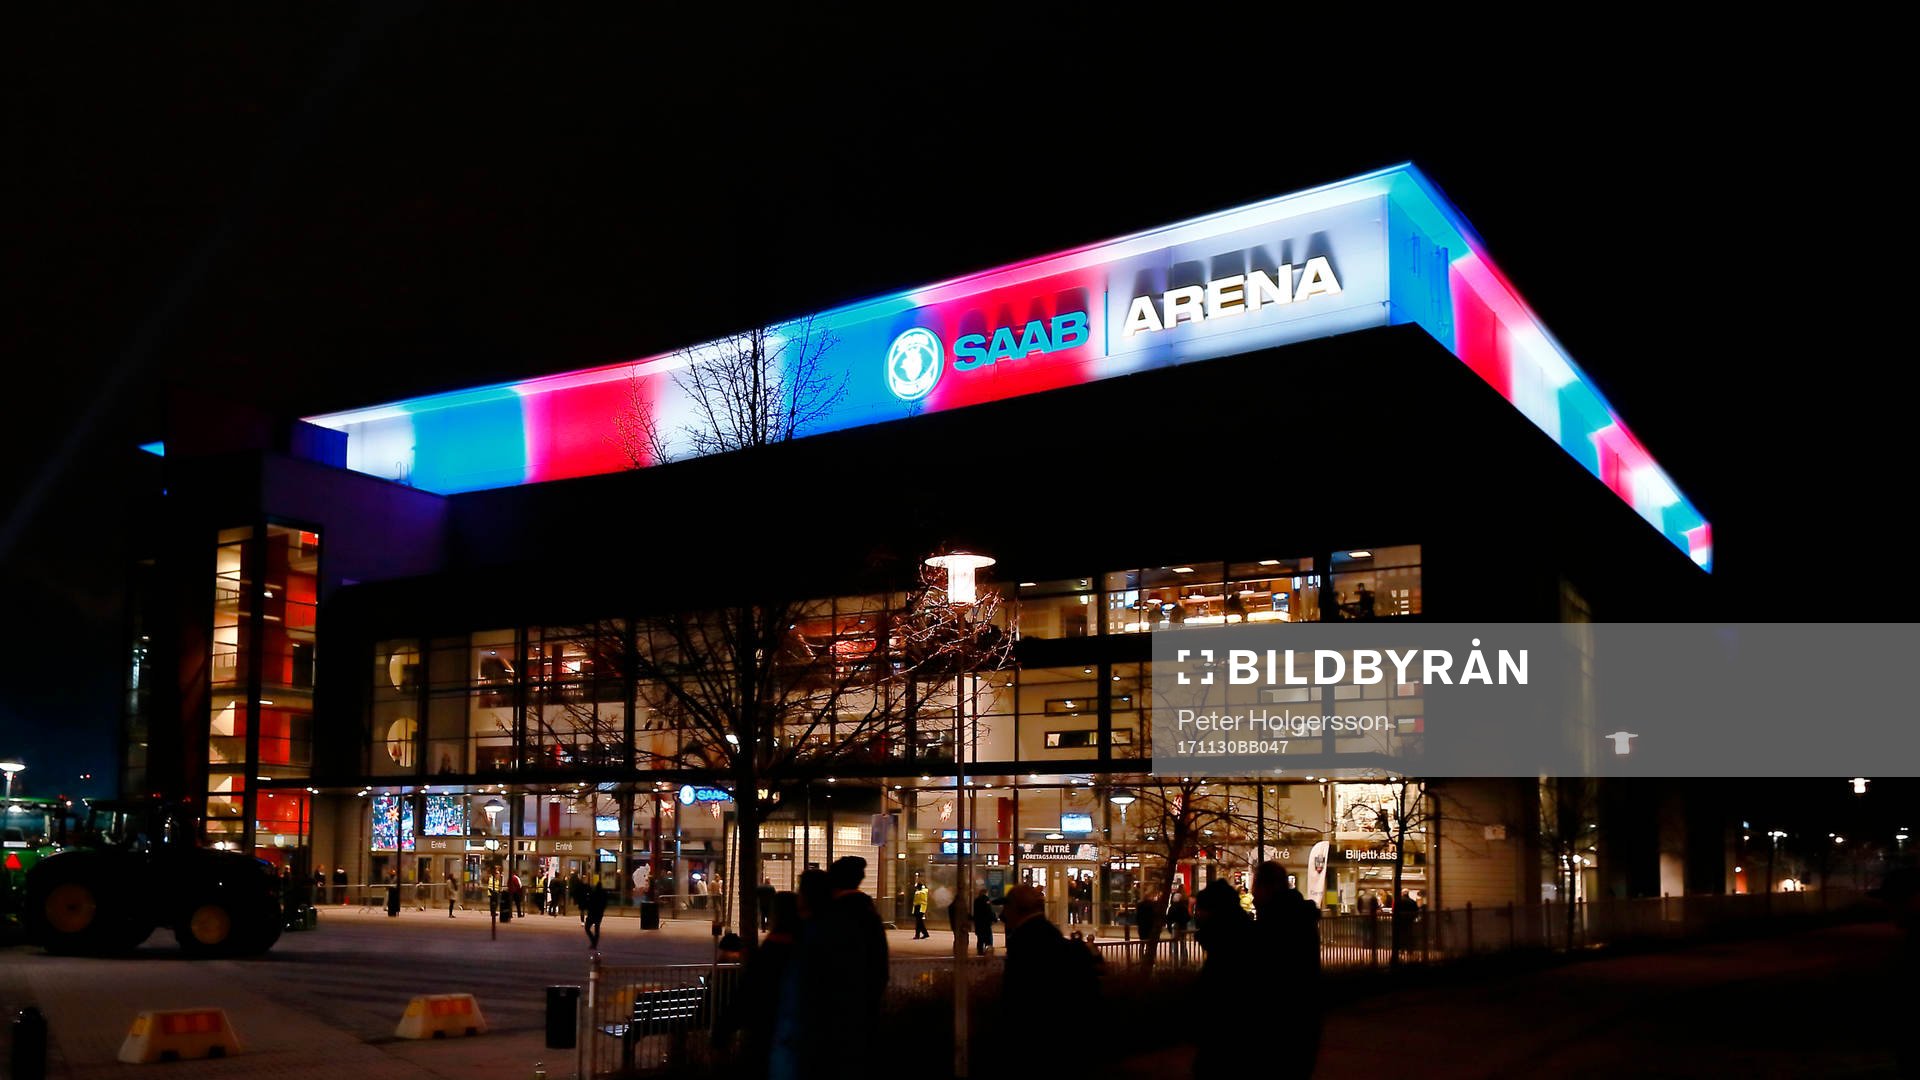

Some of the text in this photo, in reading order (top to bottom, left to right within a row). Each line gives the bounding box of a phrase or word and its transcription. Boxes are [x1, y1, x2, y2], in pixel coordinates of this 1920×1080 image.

[952, 254, 1343, 371] SAAB ARENA
[431, 841, 446, 849] Entré
[555, 841, 573, 851] Entré
[1043, 844, 1070, 853] ENTRÉ
[1345, 849, 1398, 862] Biljettkass
